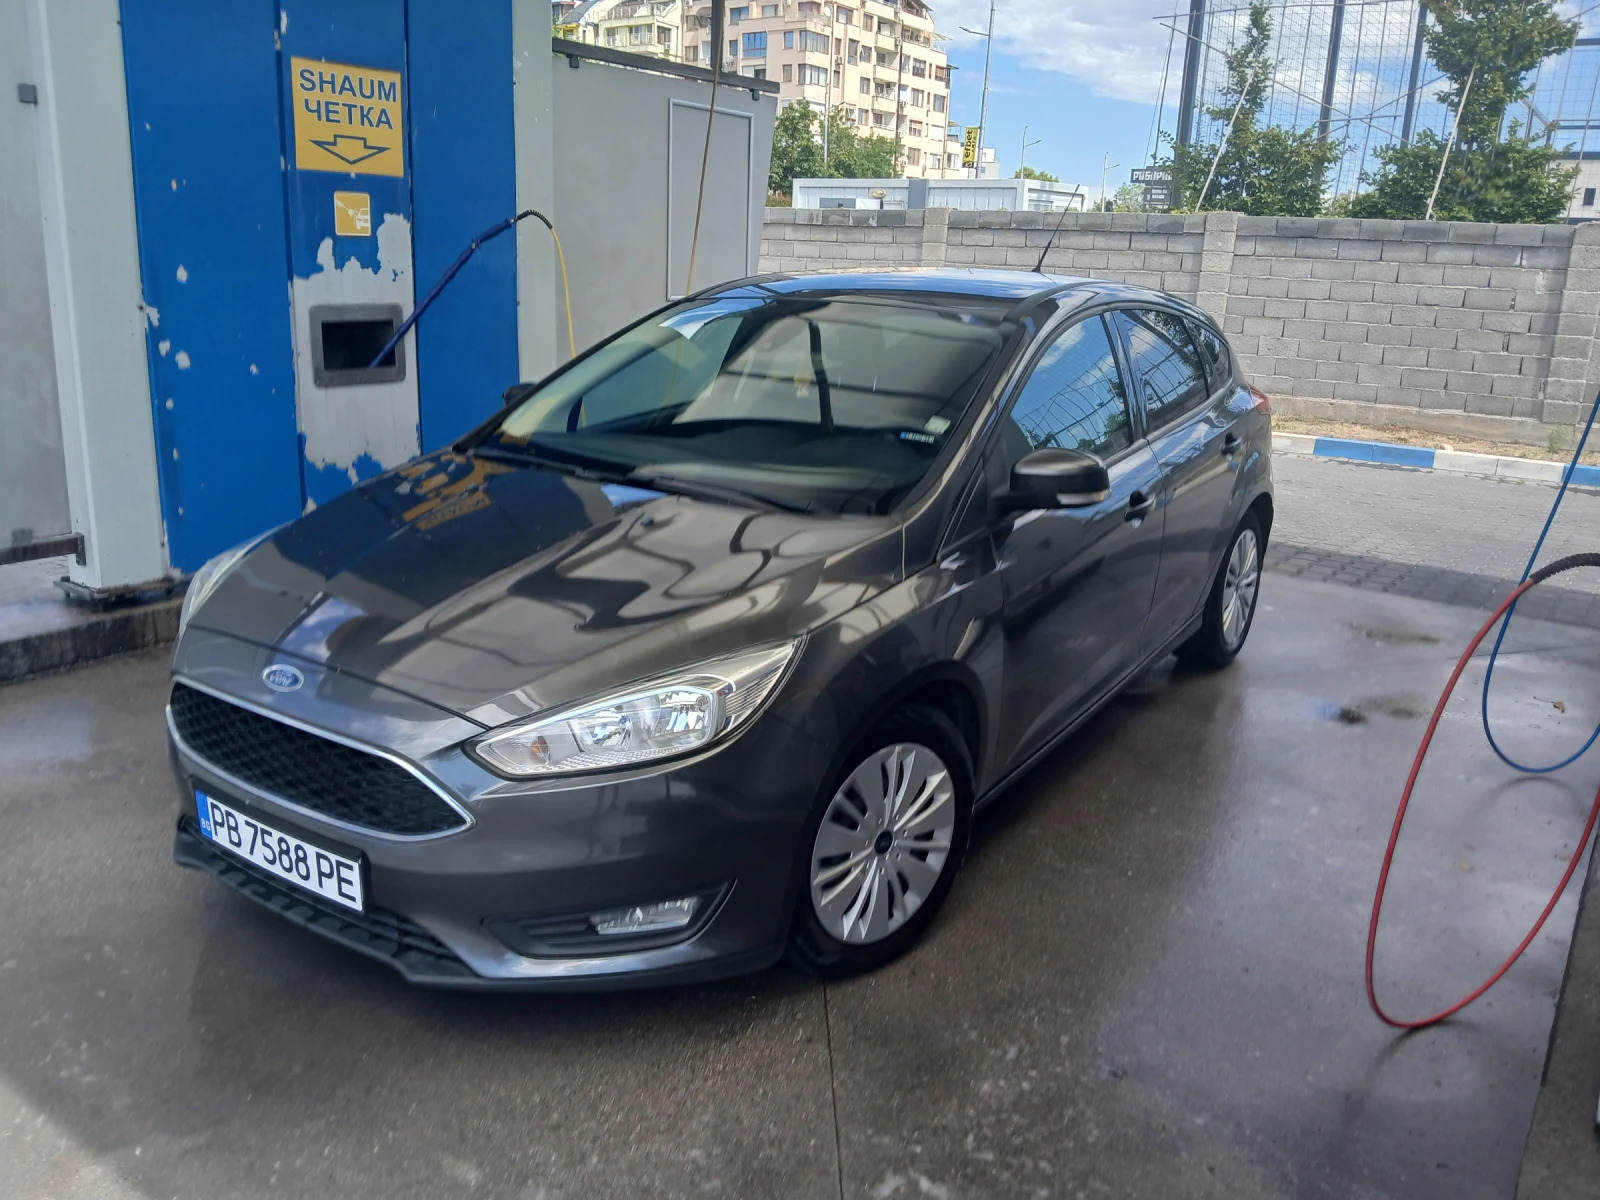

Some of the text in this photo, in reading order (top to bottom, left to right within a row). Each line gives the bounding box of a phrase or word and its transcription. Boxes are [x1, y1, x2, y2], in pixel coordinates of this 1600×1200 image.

[299, 68, 397, 102] SHAUM
[304, 98, 394, 130] ЧЕТКА
[964, 129, 973, 158] efbet
[201, 817, 212, 831] BG
